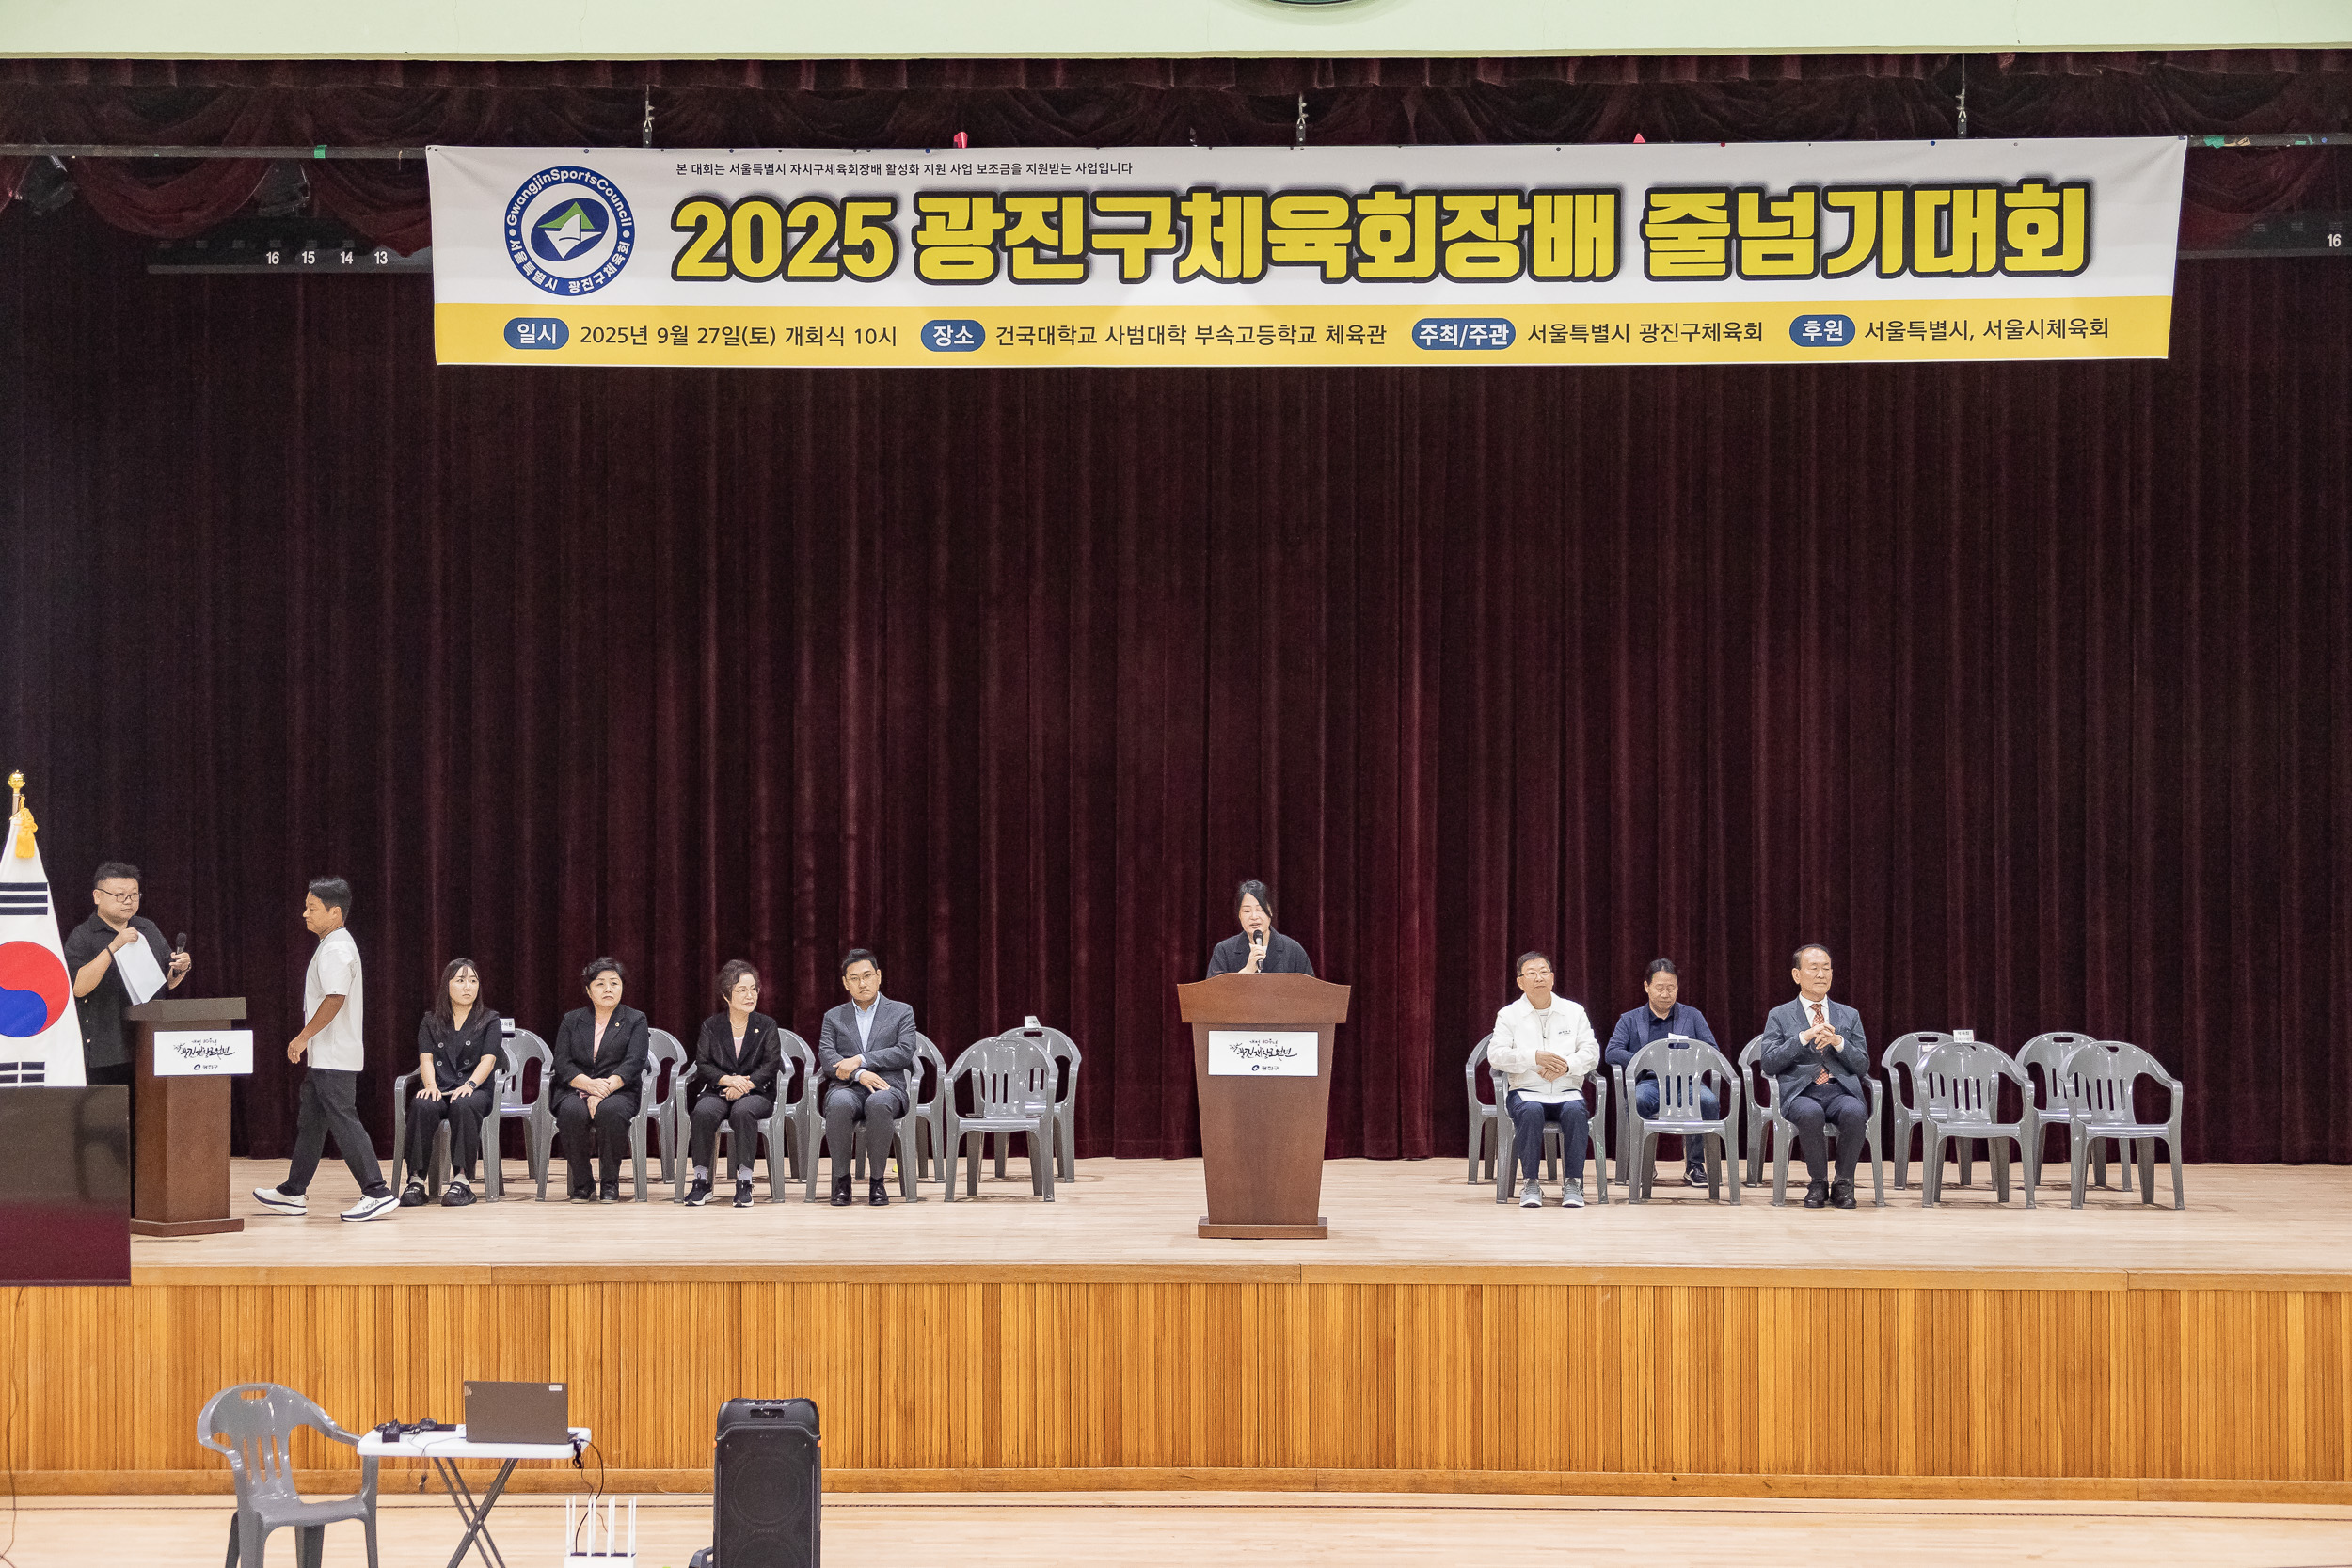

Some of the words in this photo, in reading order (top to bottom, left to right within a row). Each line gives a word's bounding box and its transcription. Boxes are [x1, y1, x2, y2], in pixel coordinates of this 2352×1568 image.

[675, 163, 688, 176] 본
[691, 163, 725, 176] 대회는
[729, 163, 786, 176] 서울특별시
[790, 163, 882, 176] 자치구체육회장배
[885, 163, 920, 176] 활성화
[923, 163, 946, 176] 지원
[950, 163, 973, 176] 사업
[977, 163, 1023, 176] 보조금을
[1025, 162, 1072, 175] 지원받는
[1075, 162, 1133, 175] 사업입니다
[506, 168, 633, 227] GwangjinSportsCouncil
[670, 195, 900, 283] 2025
[911, 184, 1622, 286] 광진구체육회장배
[1640, 178, 2091, 282] 줄넘기대회
[2327, 233, 2342, 247] 16
[266, 251, 280, 265] 16
[301, 250, 316, 264] 15
[340, 251, 354, 265] 14
[373, 250, 389, 265] 13
[509, 239, 558, 291] 서울특별시
[568, 241, 630, 293] 광진구체육회
[516, 323, 557, 345] 일시
[580, 325, 648, 346] 2025년
[657, 325, 689, 346] 9월
[697, 325, 776, 347] 27일(토)
[785, 325, 844, 347] 개회식
[854, 325, 898, 347] 10시
[932, 325, 975, 347] 장소
[995, 325, 1098, 346] 건국대학교
[1104, 325, 1187, 346] 사범대학
[1194, 325, 1318, 346] 부속고등학교
[1325, 325, 1387, 345] 체육관
[1419, 323, 1509, 348] 주최/주관
[1527, 322, 1629, 344] 서울특별시
[1639, 321, 1762, 344] 광진구체육회
[1802, 320, 1844, 341] 후원
[1864, 319, 1975, 342] 서울특별시,
[1982, 317, 2109, 341] 서울시체육회
